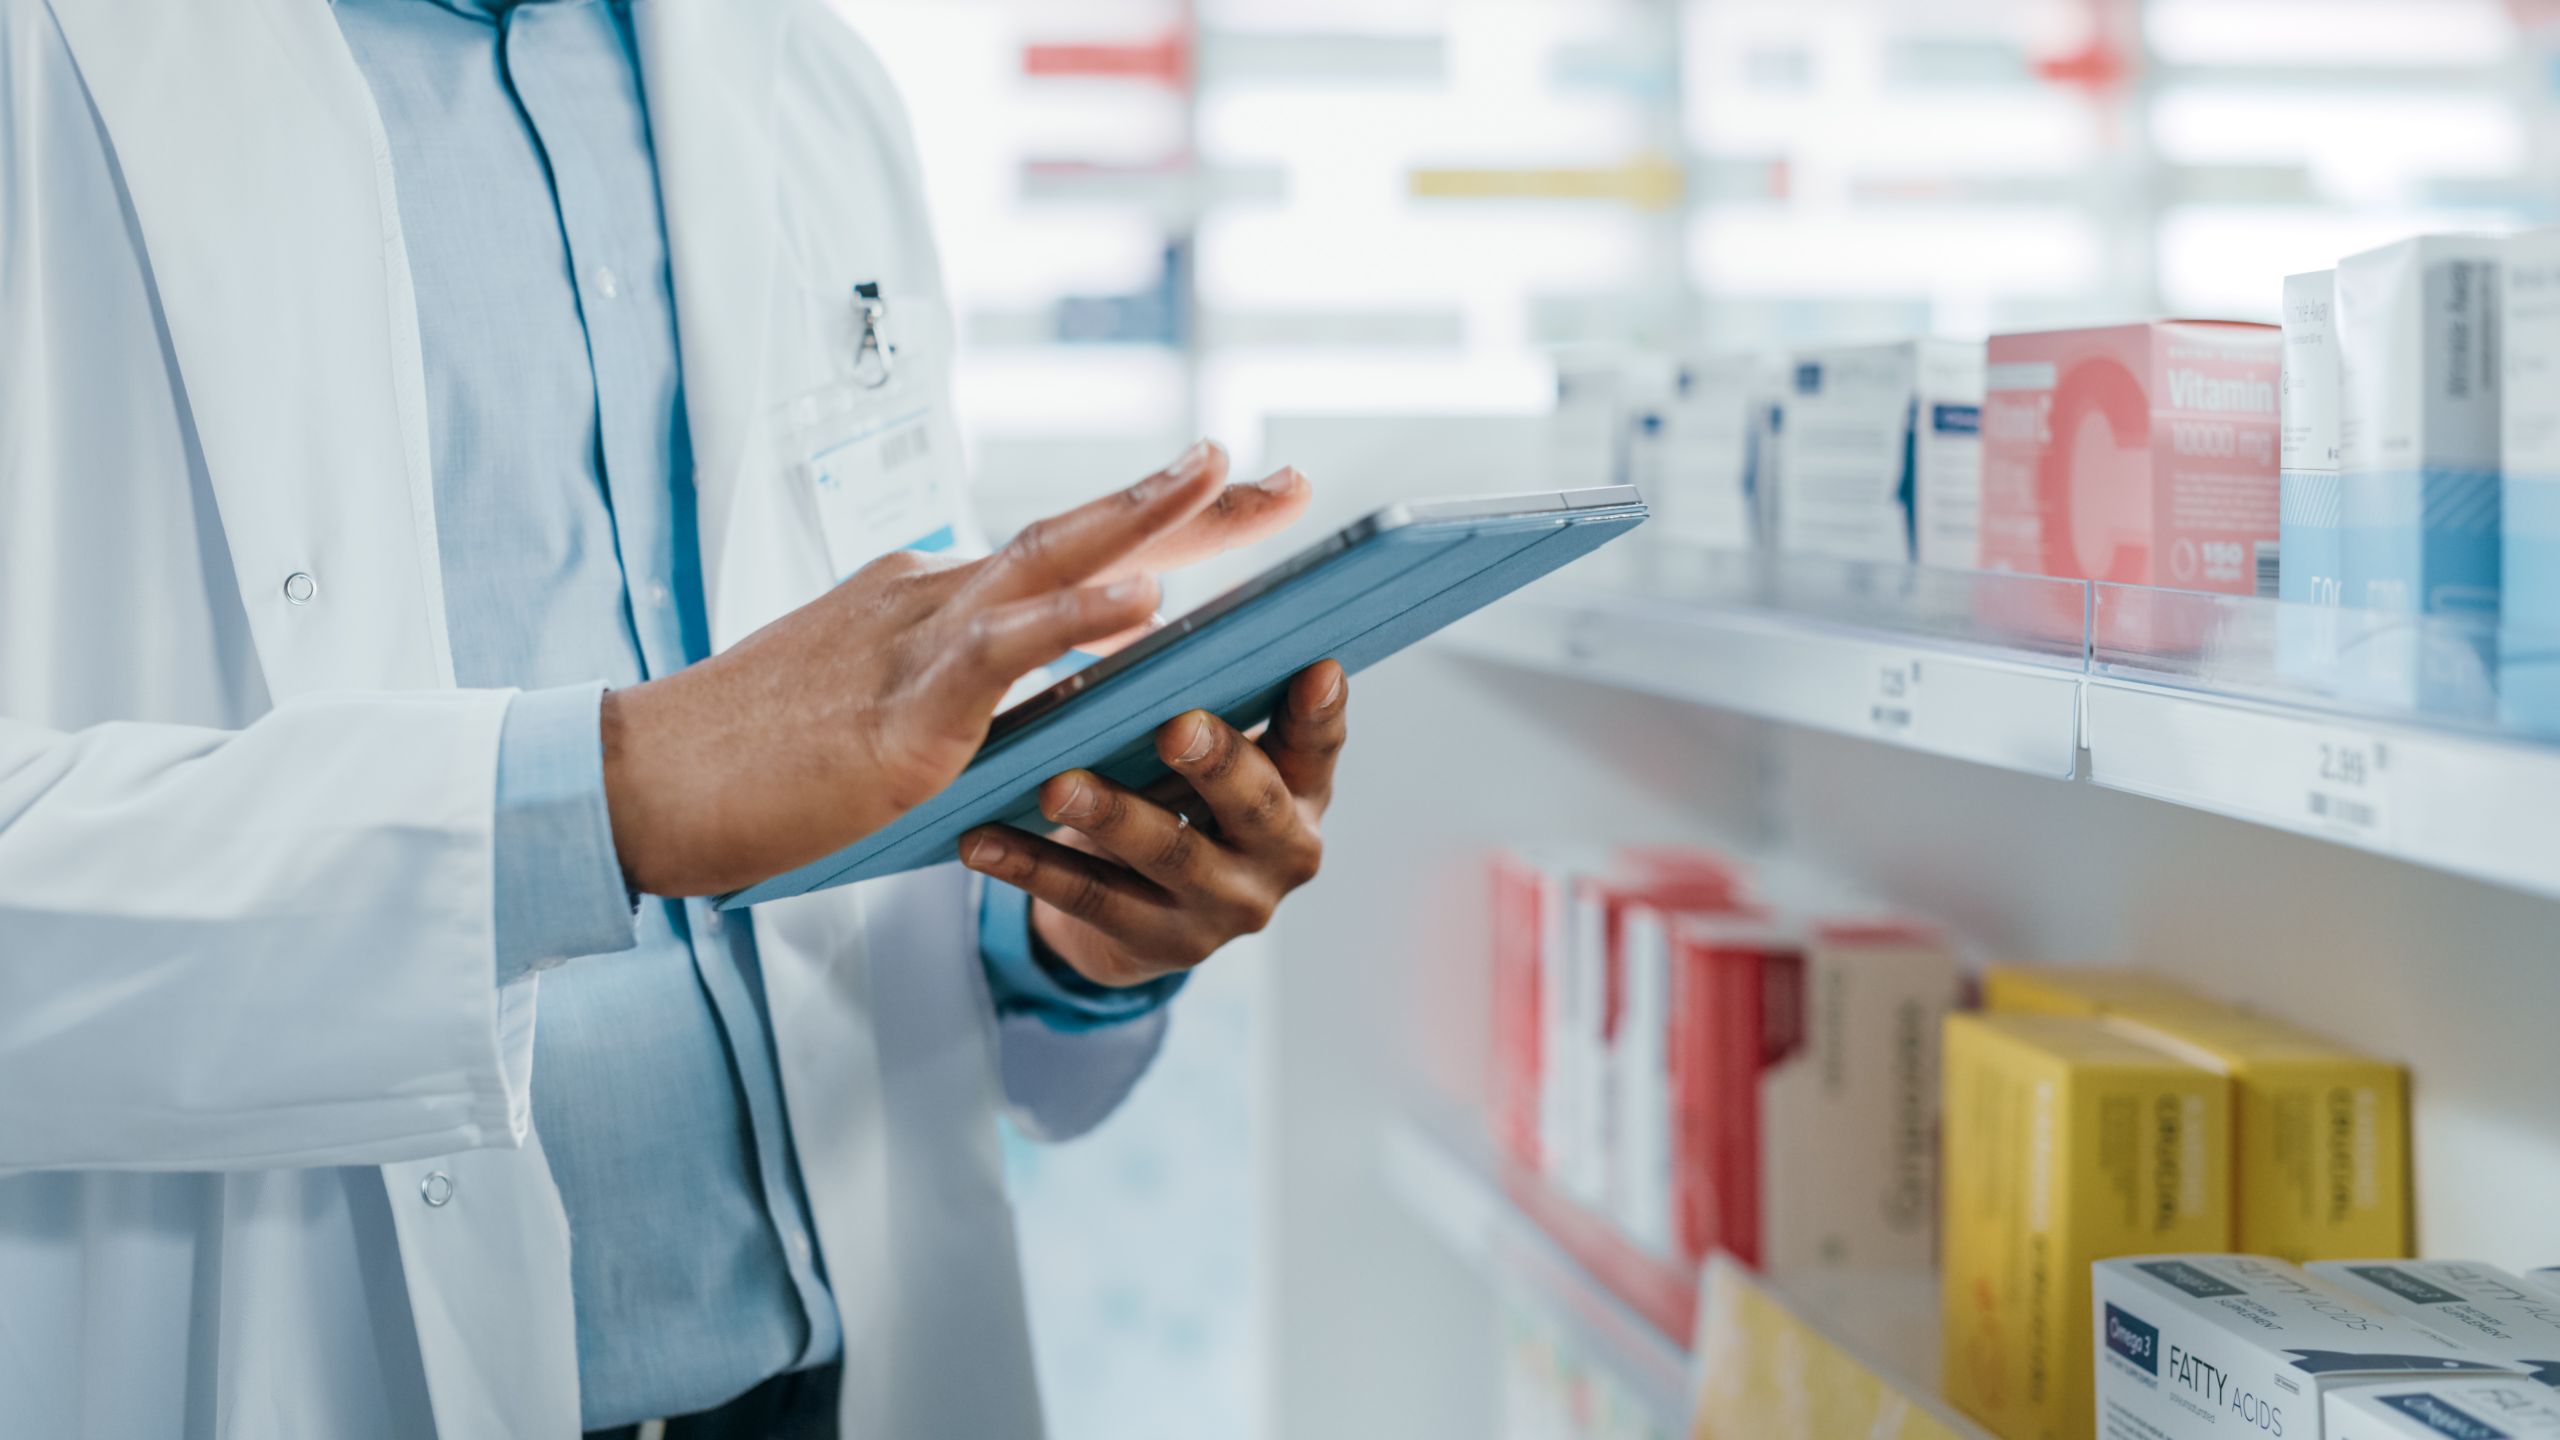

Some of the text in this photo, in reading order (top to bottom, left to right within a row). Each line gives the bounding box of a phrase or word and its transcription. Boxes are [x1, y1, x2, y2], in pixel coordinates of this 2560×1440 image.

[2167, 366, 2274, 413] Vitamin
[2109, 1316, 2152, 1357] Omega 3
[2170, 1345, 2228, 1406] FATTY
[2231, 1387, 2283, 1438] ACIDS
